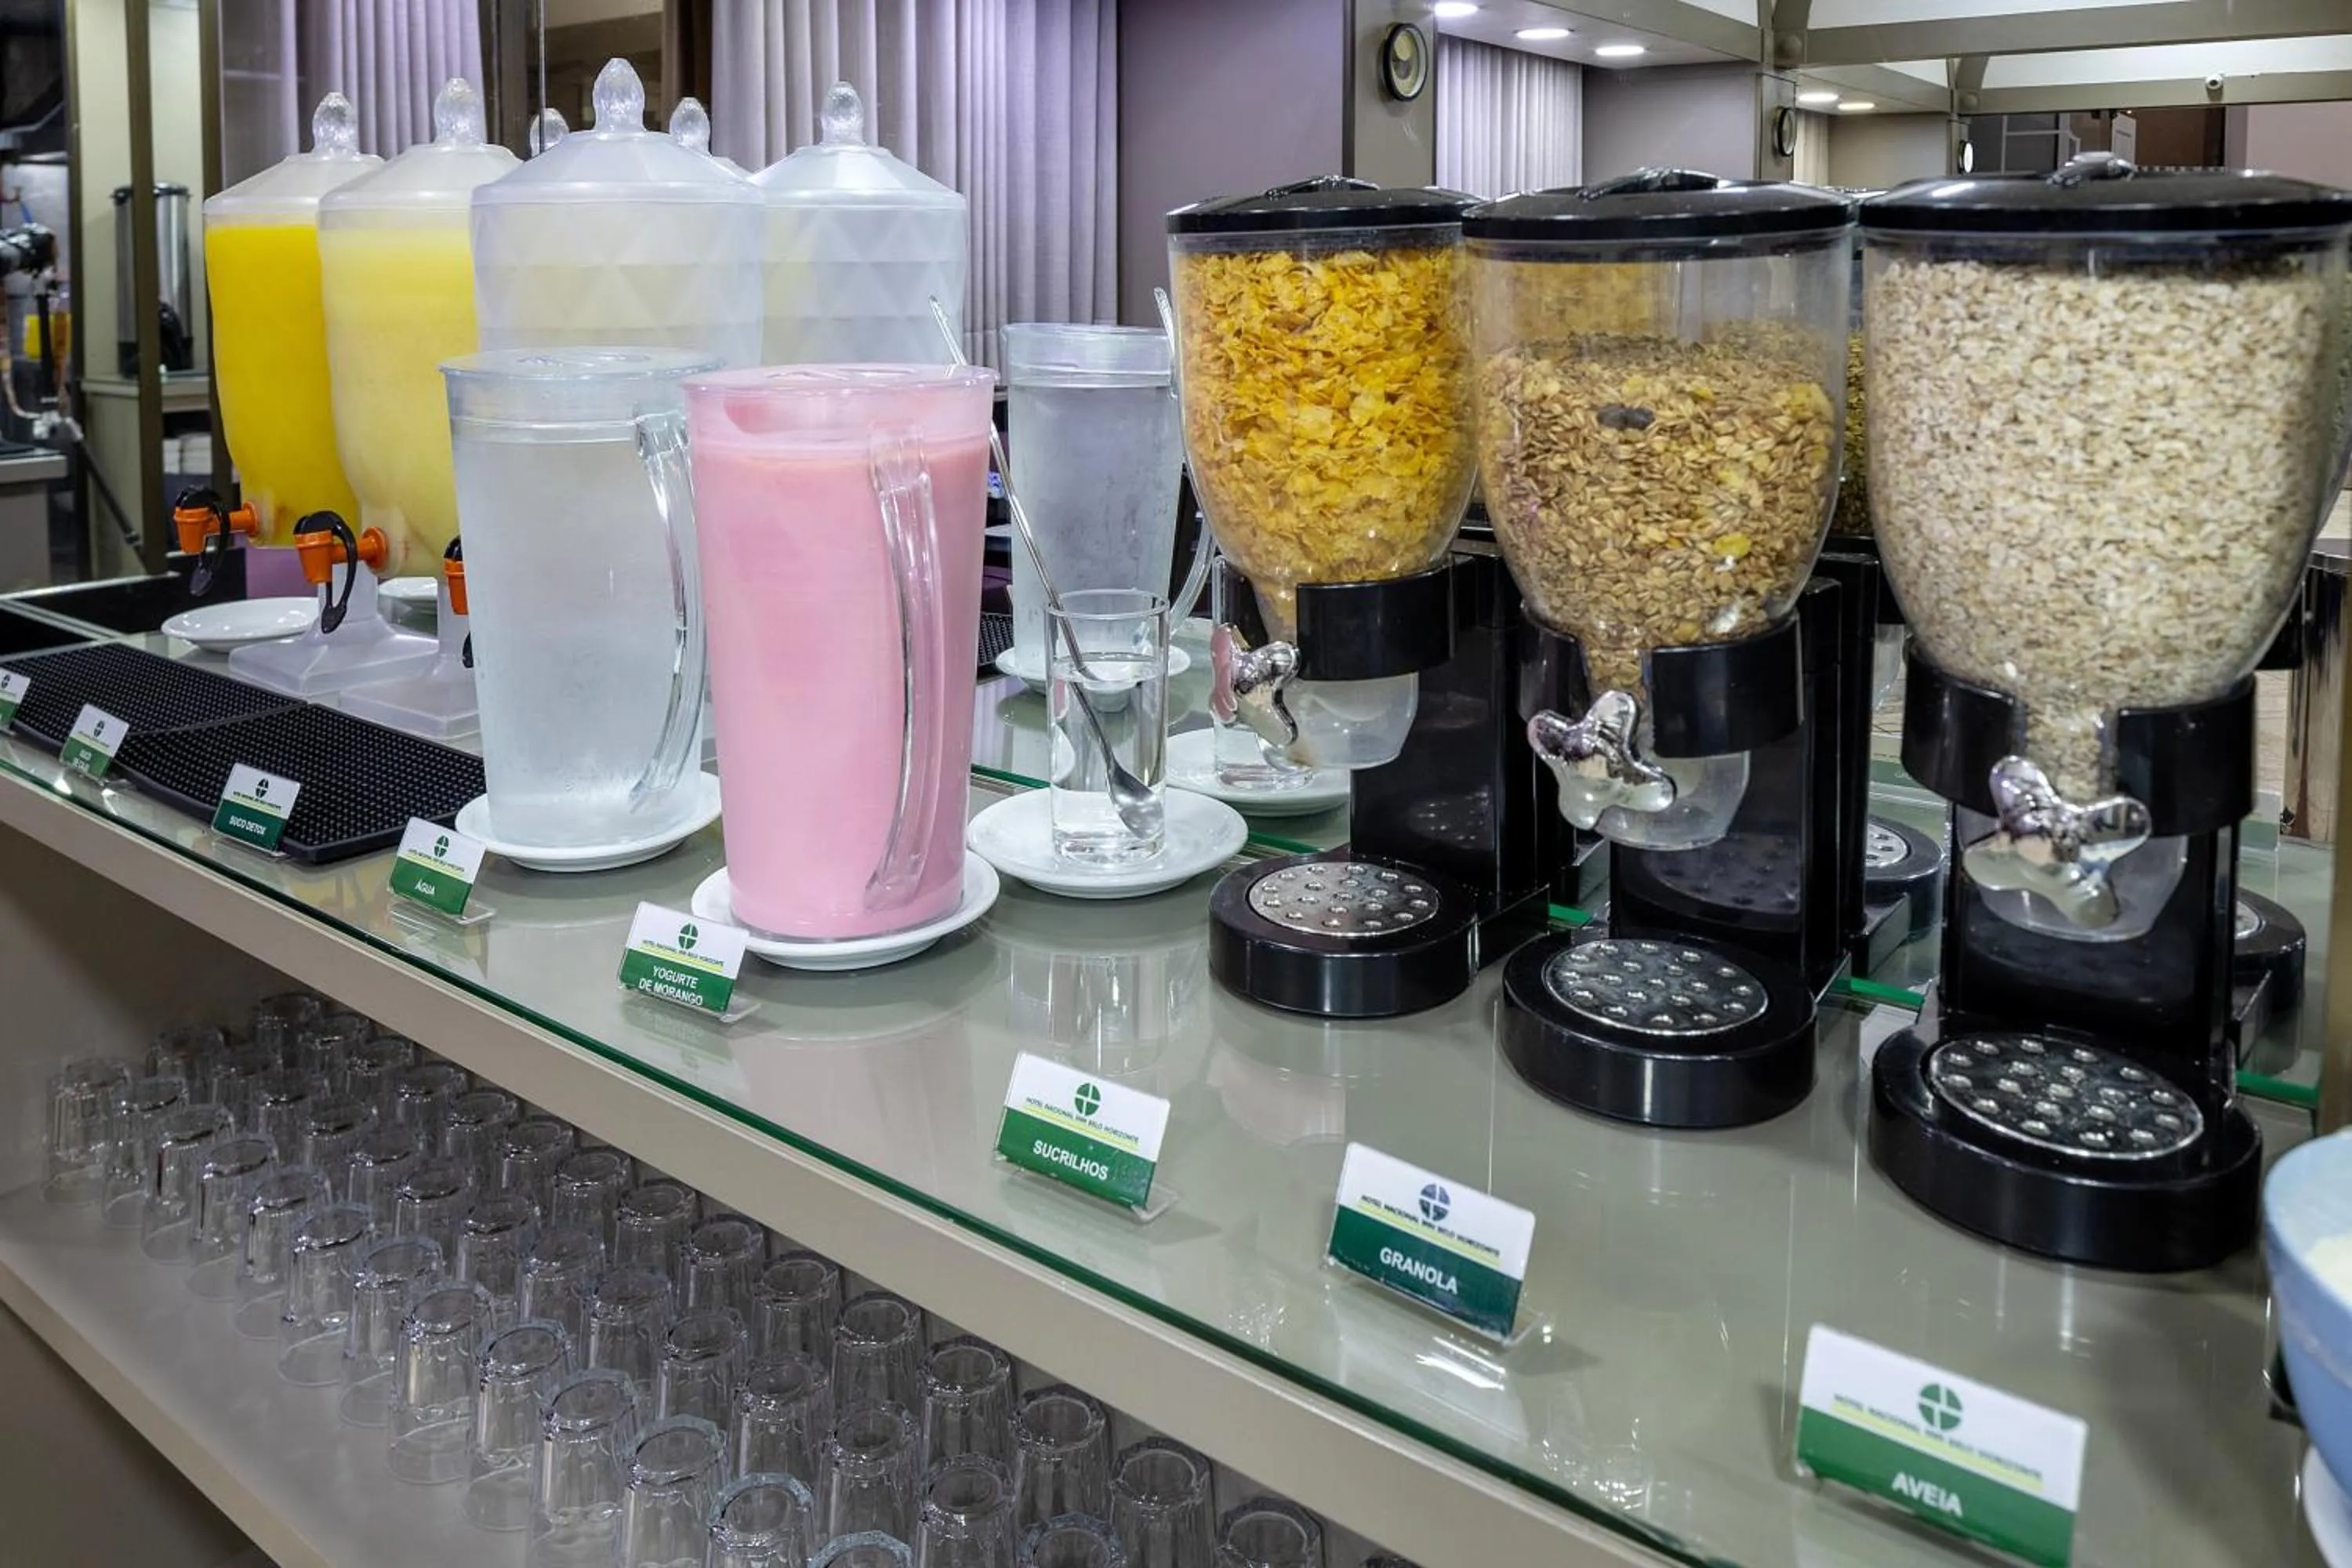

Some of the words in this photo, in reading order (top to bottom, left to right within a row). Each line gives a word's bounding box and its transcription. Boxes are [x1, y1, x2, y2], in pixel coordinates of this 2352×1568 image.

[639, 978, 652, 993] DE
[653, 984, 703, 1007] MORANGO
[652, 965, 699, 989] YOGURTE
[1033, 1140, 1109, 1181] SUCRILHOS
[1379, 1247, 1458, 1295] GRANOLA
[1891, 1472, 1963, 1518] AVEIA
